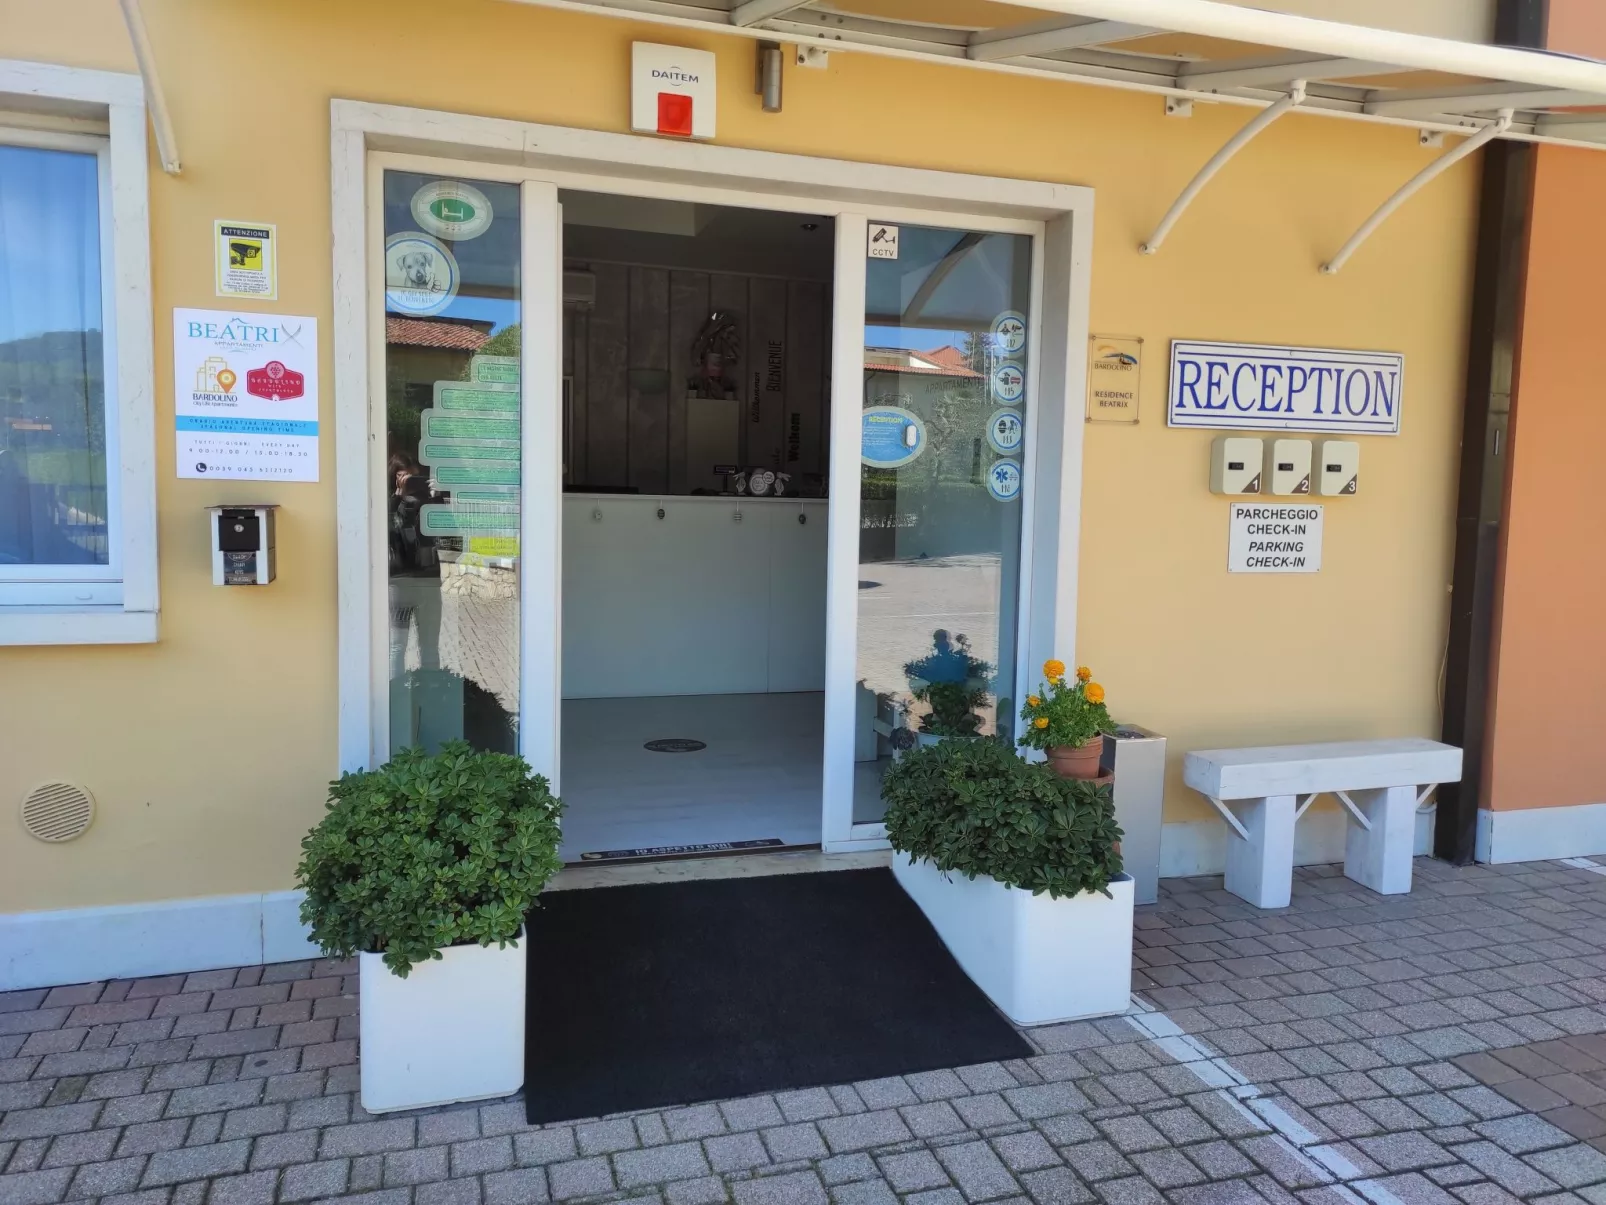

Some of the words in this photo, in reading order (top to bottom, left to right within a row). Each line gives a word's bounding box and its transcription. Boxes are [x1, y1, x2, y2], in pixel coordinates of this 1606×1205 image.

[652, 69, 699, 83] DAITEM
[223, 228, 268, 238] ATTENZIONE
[872, 248, 894, 257] CCTV
[187, 320, 304, 349] BEATRIX
[766, 339, 782, 392] BIENVENUE
[1094, 363, 1132, 372] BARDOLINO
[1175, 359, 1398, 417] RECEPTION
[192, 393, 238, 402] BARDOLINO
[1095, 390, 1134, 399] RESIDENCE
[1099, 400, 1129, 408] BEATRIX
[787, 412, 800, 463] Welkom
[1252, 479, 1259, 490] 1
[1301, 479, 1309, 491] 2
[1348, 480, 1356, 492] 3
[1236, 508, 1318, 520] PARCHEGGIO
[1247, 524, 1306, 535] CHECK-IN
[1248, 541, 1304, 552] PARKING
[1246, 556, 1306, 567] CHECK-IN
